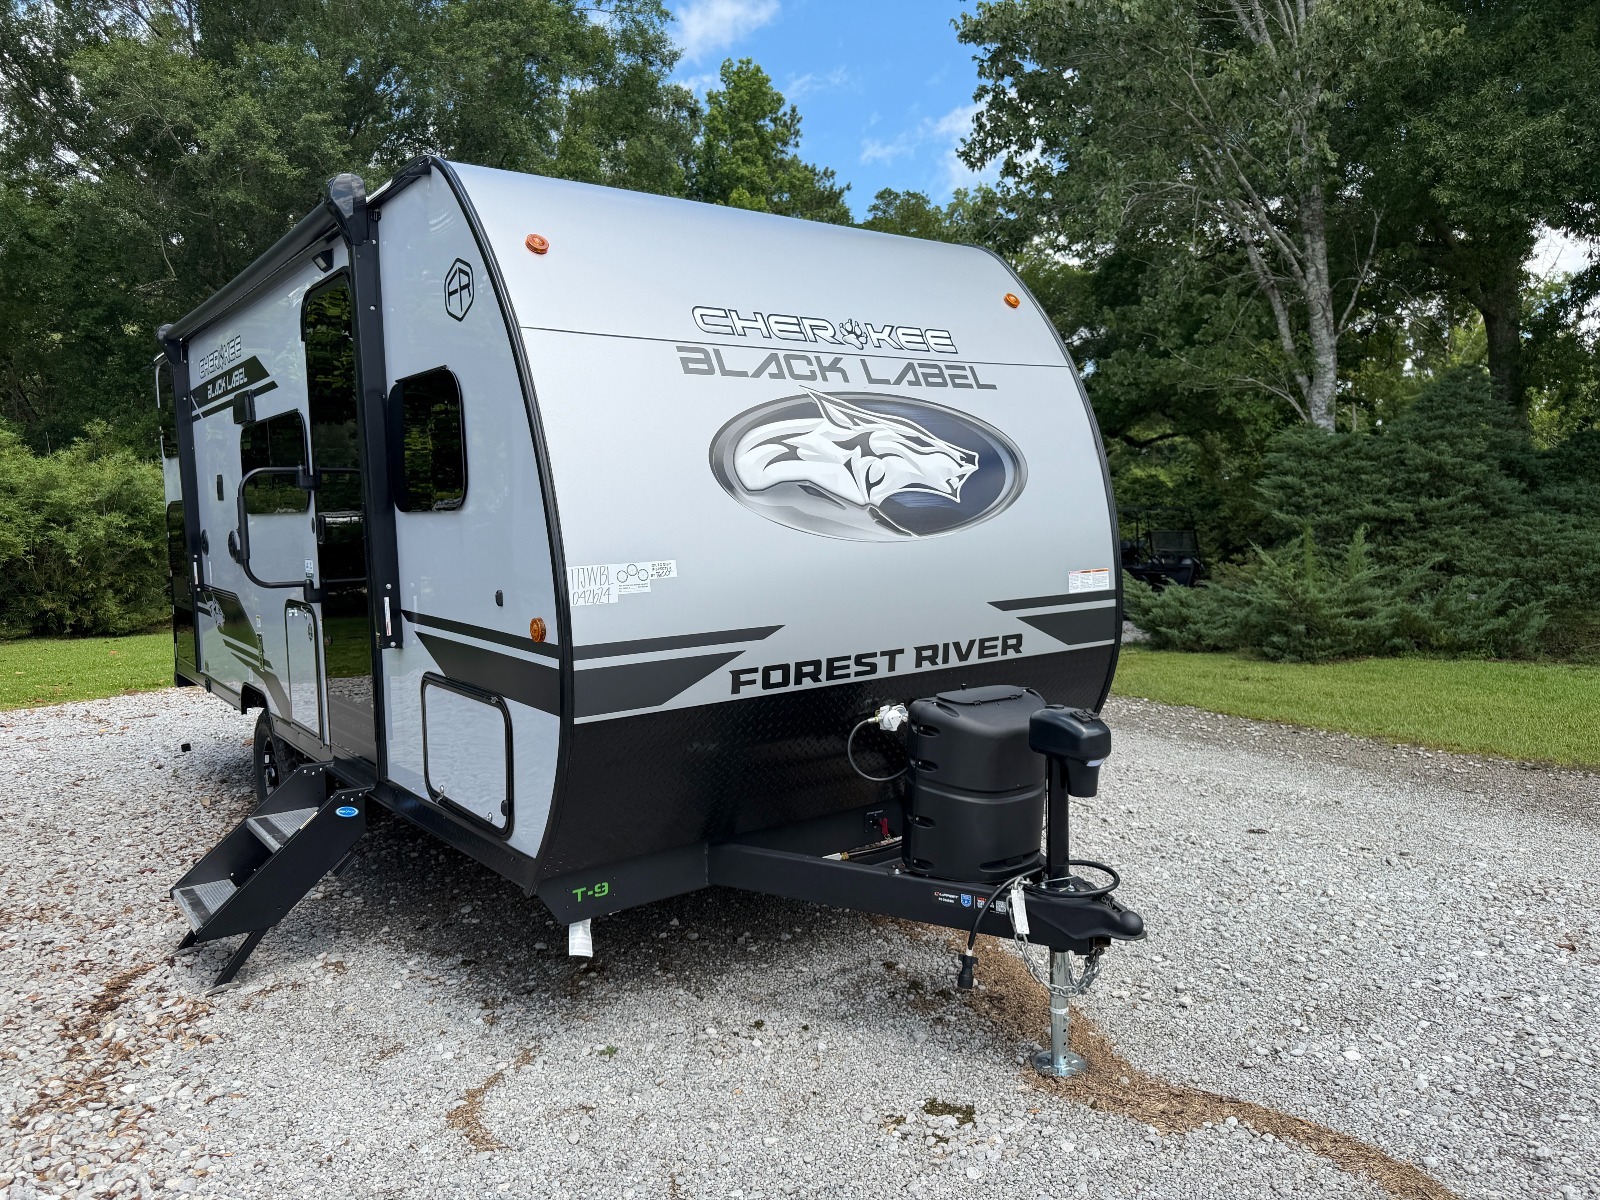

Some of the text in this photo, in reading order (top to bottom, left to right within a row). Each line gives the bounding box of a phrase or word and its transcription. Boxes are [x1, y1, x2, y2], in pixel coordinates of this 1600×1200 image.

[691, 305, 958, 354] CHEROKEE
[207, 367, 248, 399] BLACK LABEL
[676, 345, 997, 391] BLACK LABEL
[729, 633, 1023, 695] FOREST RIVER
[572, 882, 609, 902] T-9
